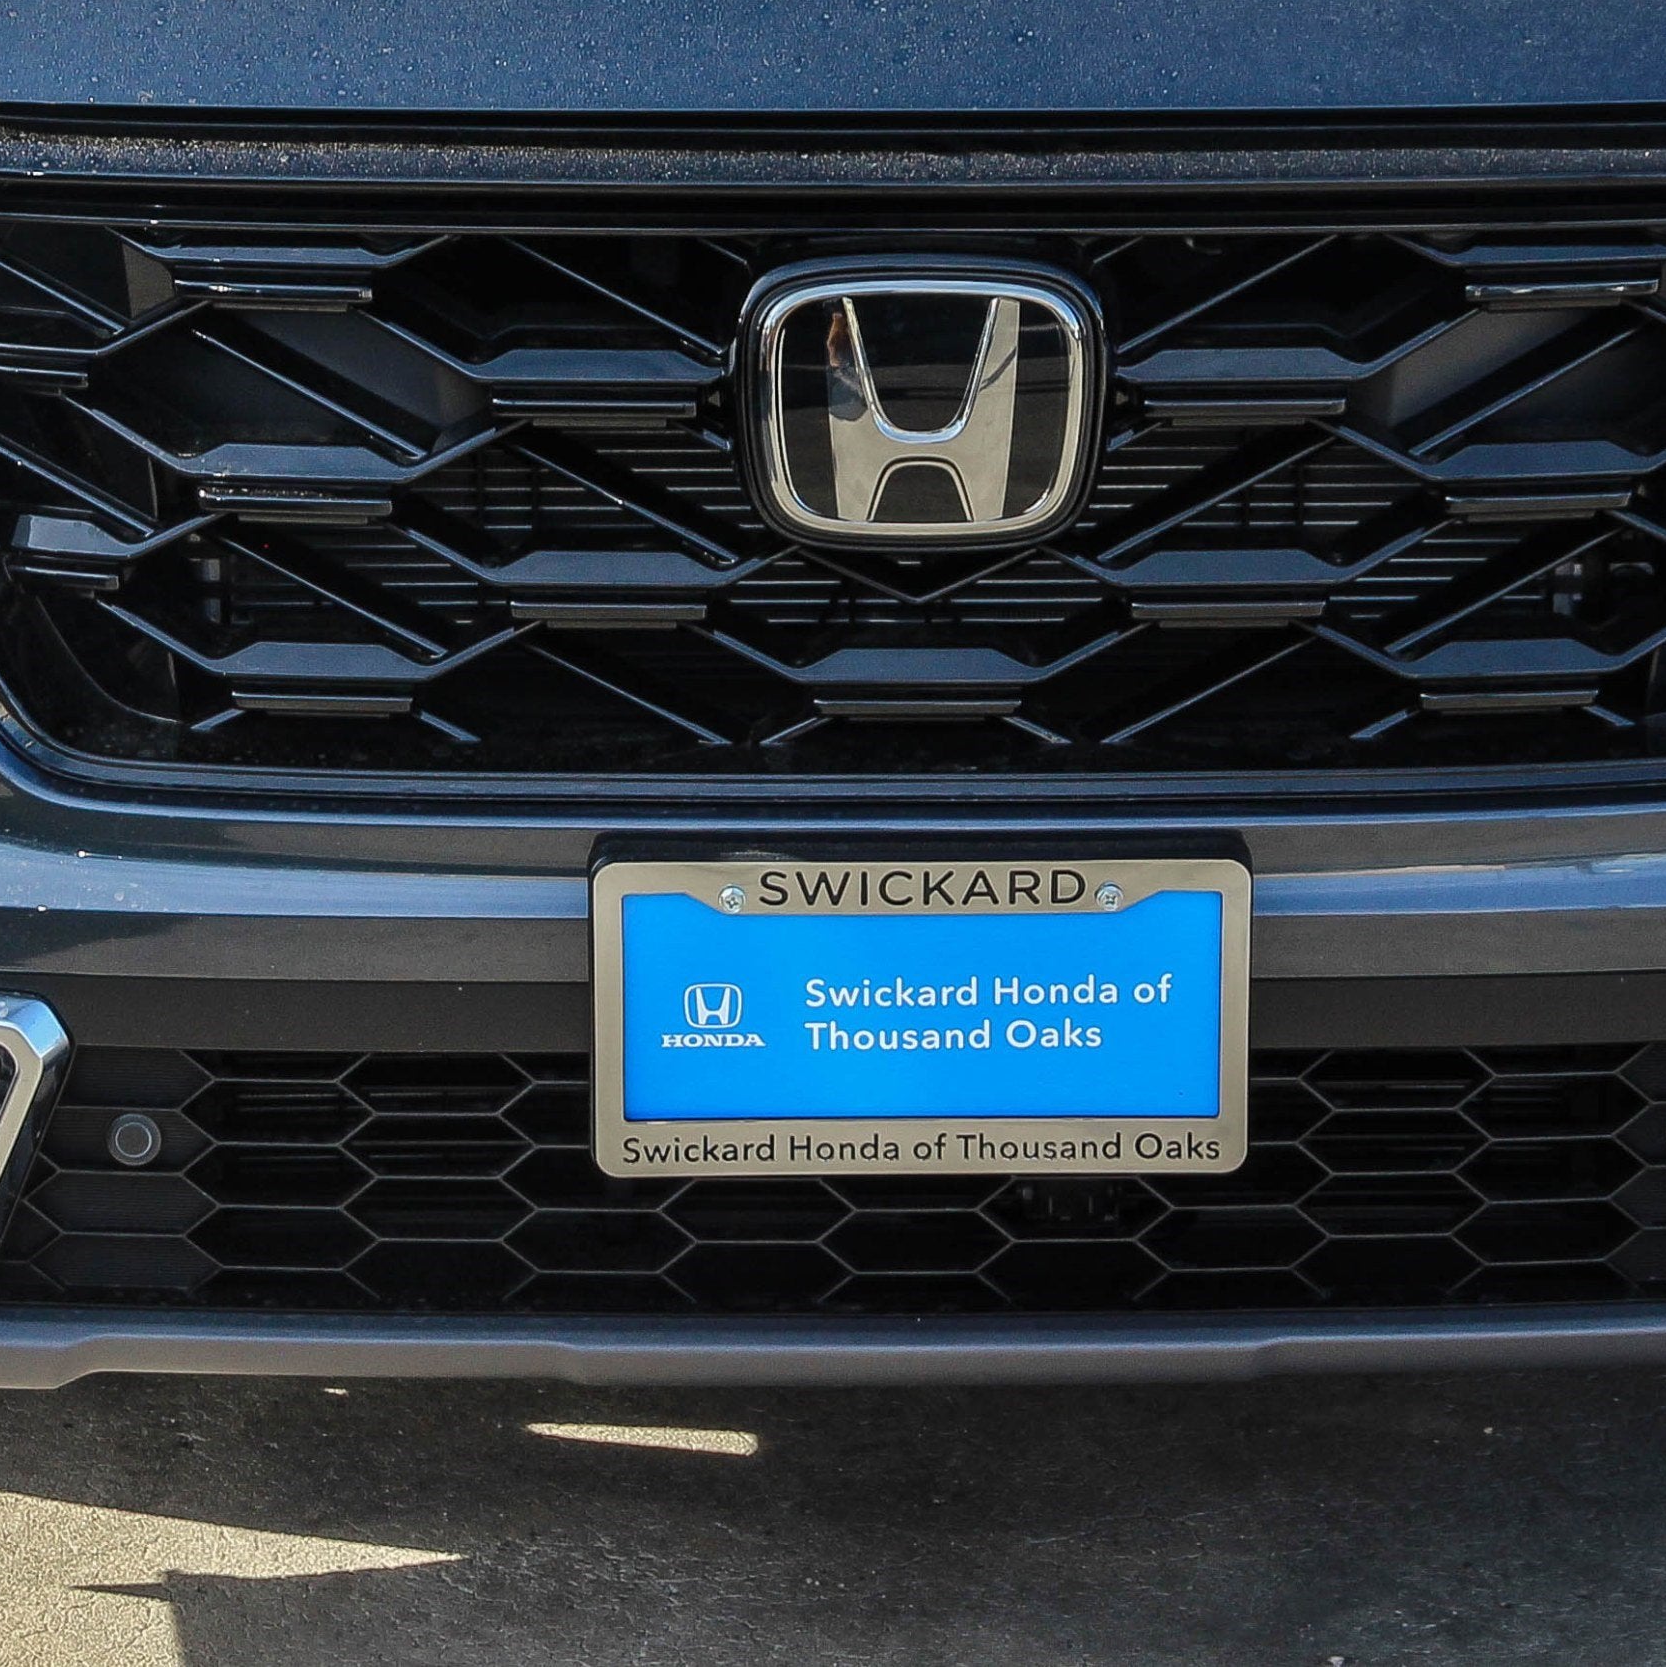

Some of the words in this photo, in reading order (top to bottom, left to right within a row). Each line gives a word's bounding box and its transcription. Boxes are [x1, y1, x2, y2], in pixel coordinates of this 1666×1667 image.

[759, 869, 1086, 906] SWICKARD
[806, 976, 977, 1007] Swickard
[994, 974, 1118, 1005] Honda
[1133, 973, 1172, 1003] of
[662, 1033, 765, 1048] HONDA
[804, 1019, 990, 1050] Thousand
[1006, 1018, 1102, 1048] Oaks
[623, 1134, 775, 1164] Swickard
[789, 1133, 899, 1161] Honda
[913, 1132, 947, 1161] of
[956, 1131, 1121, 1160] Thousand
[1134, 1131, 1220, 1160] Oaks
